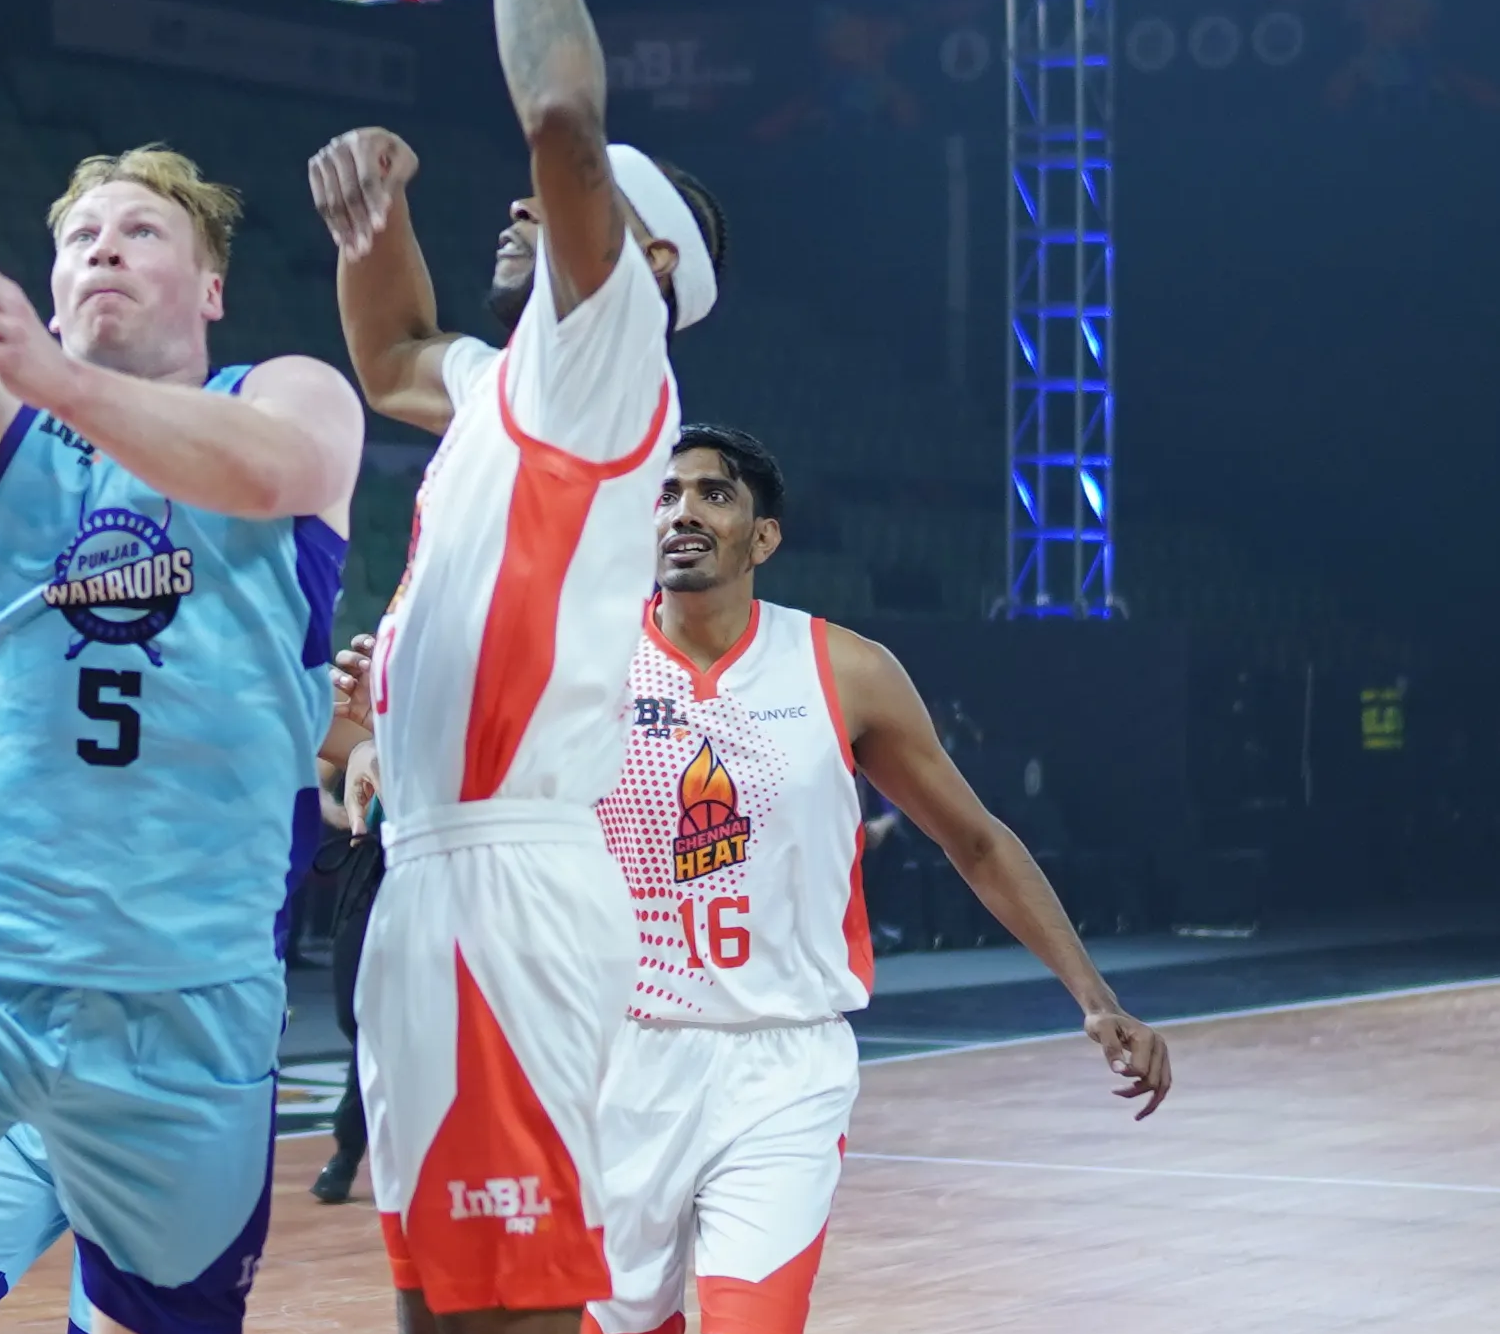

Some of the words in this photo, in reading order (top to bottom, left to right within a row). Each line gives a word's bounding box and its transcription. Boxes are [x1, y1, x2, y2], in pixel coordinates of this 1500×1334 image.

[42, 548, 194, 605] WARRIORS
[77, 542, 140, 571] PUNJAB
[76, 667, 142, 768] 5
[749, 706, 808, 722] PUNVEC
[674, 833, 750, 882] HEAT
[675, 820, 749, 852] CHENNAI
[677, 895, 751, 969] 16
[446, 1175, 552, 1221] InBL
